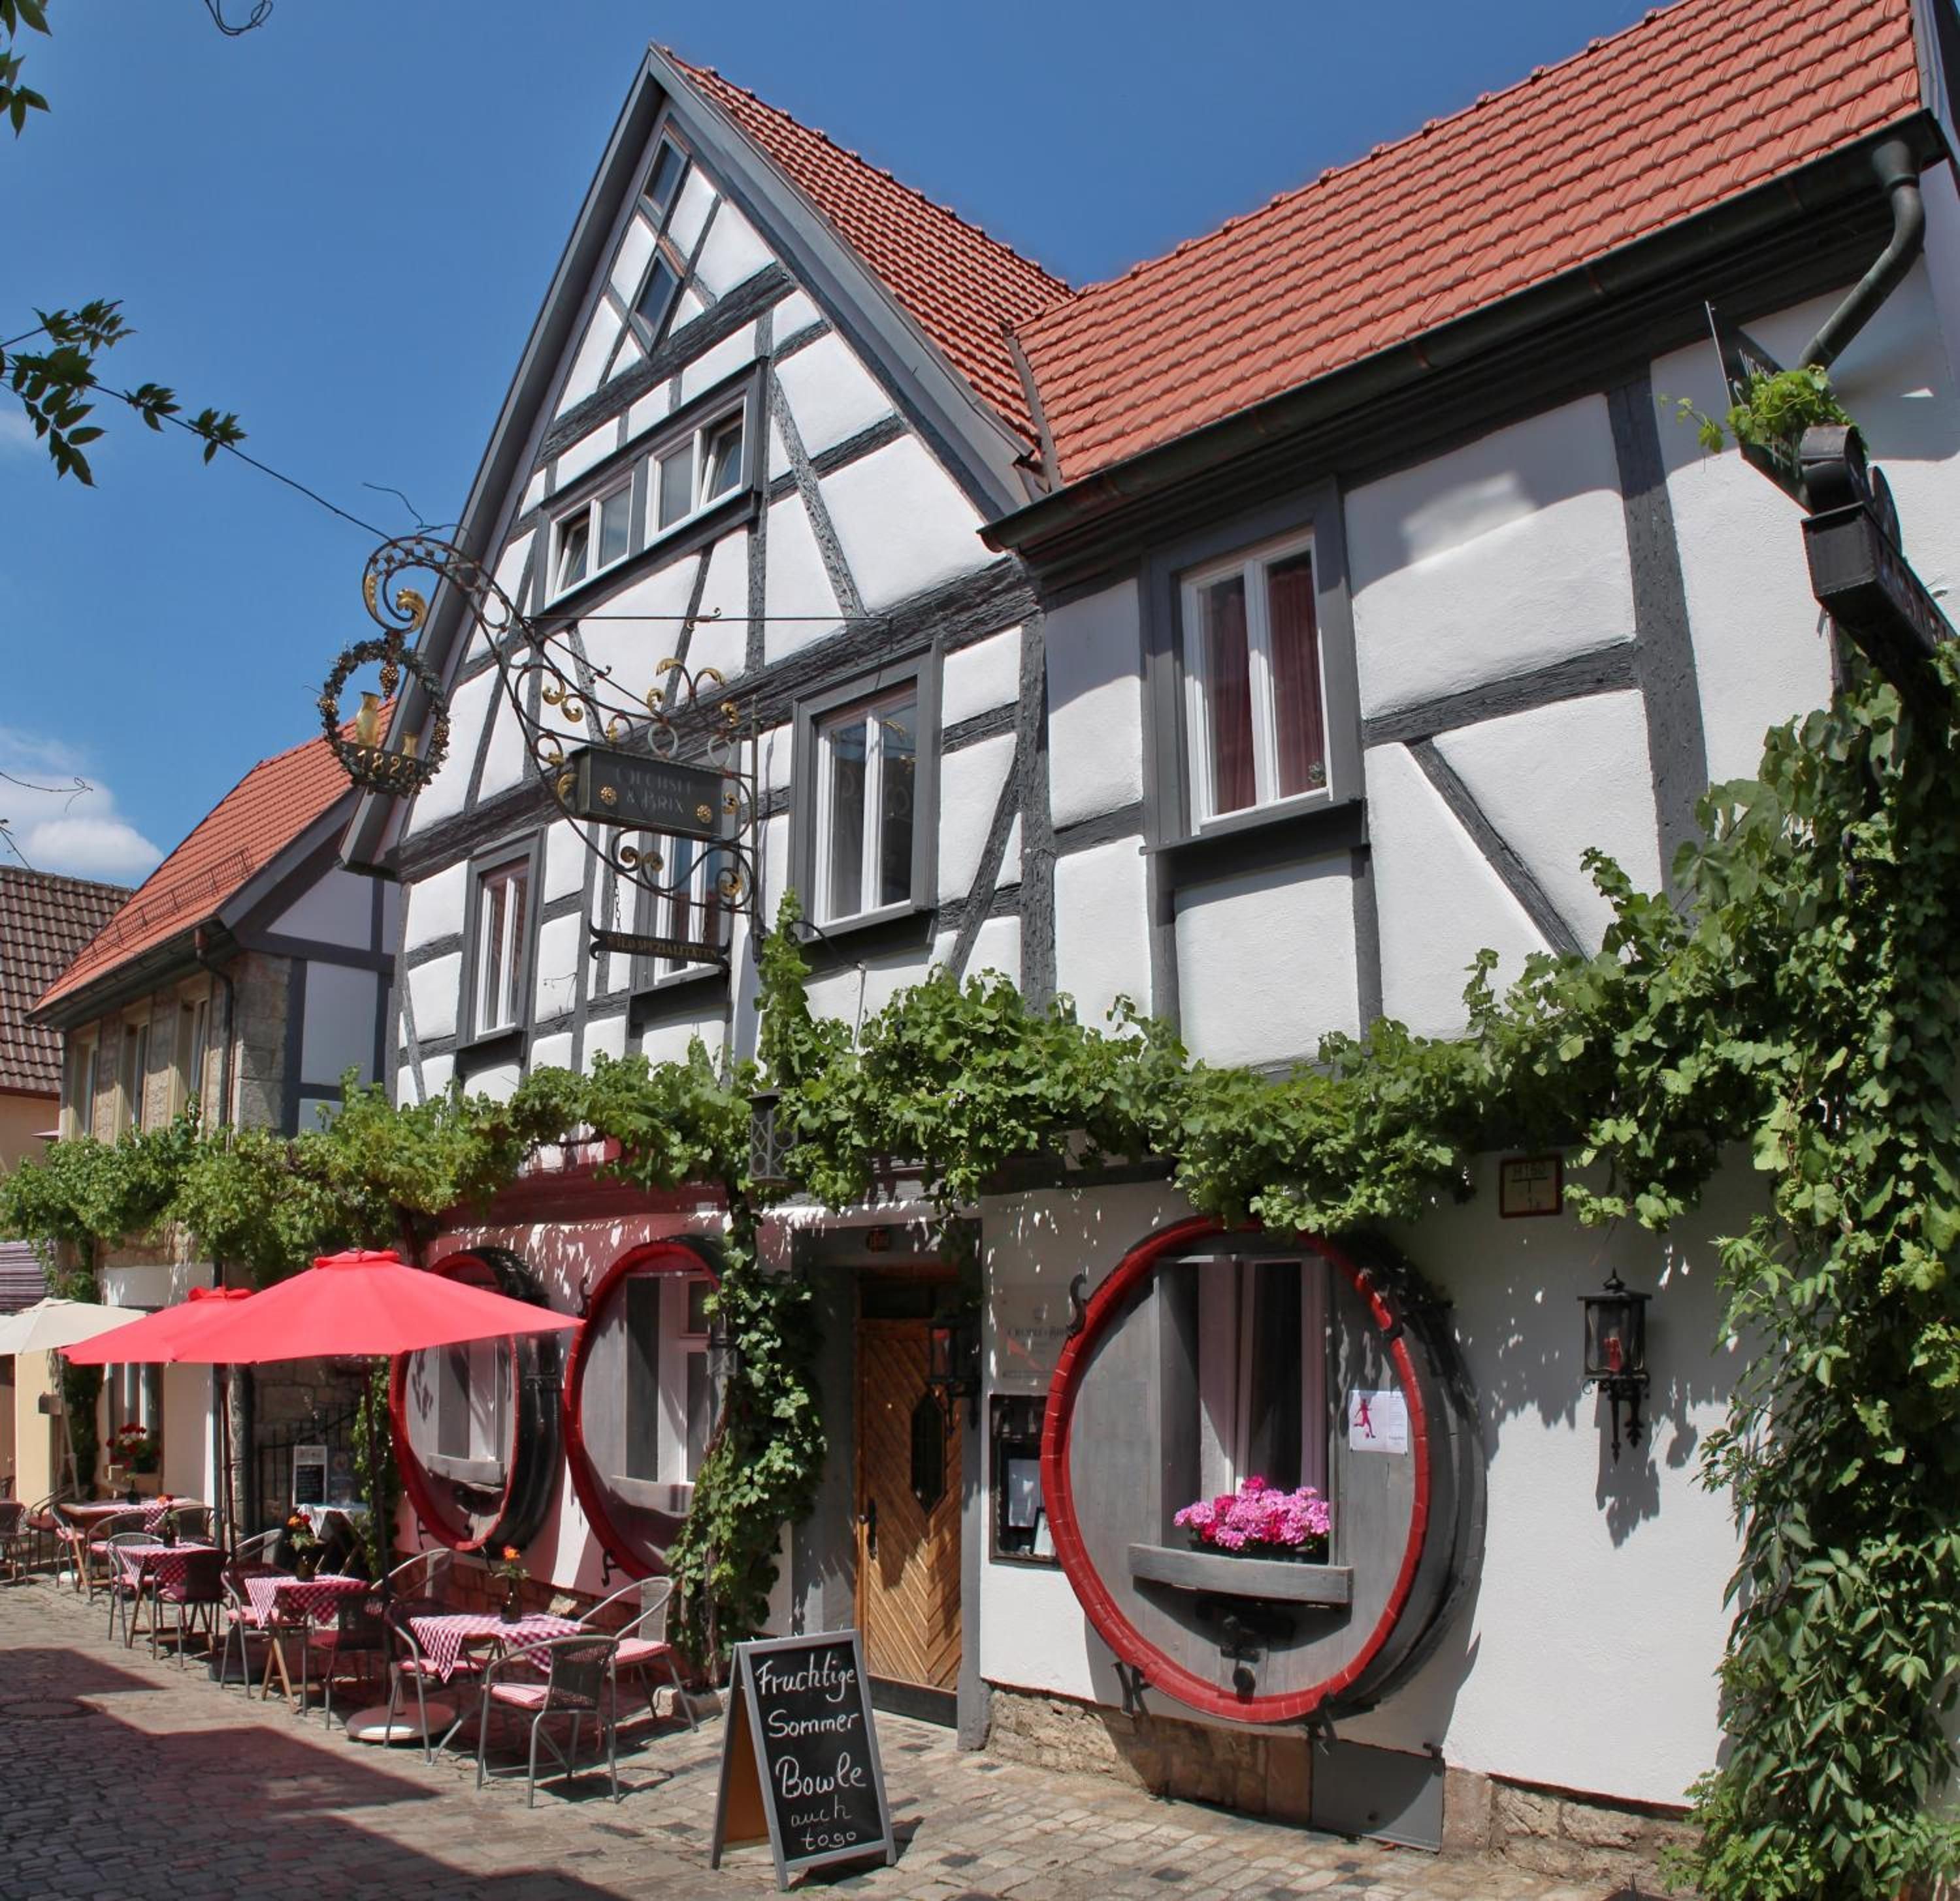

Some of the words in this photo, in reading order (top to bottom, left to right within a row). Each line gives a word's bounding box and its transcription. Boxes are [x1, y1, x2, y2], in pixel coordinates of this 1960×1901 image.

[768, 1710, 860, 1738] Sommer
[776, 1751, 866, 1798] Bowle
[791, 1795, 853, 1827] auch
